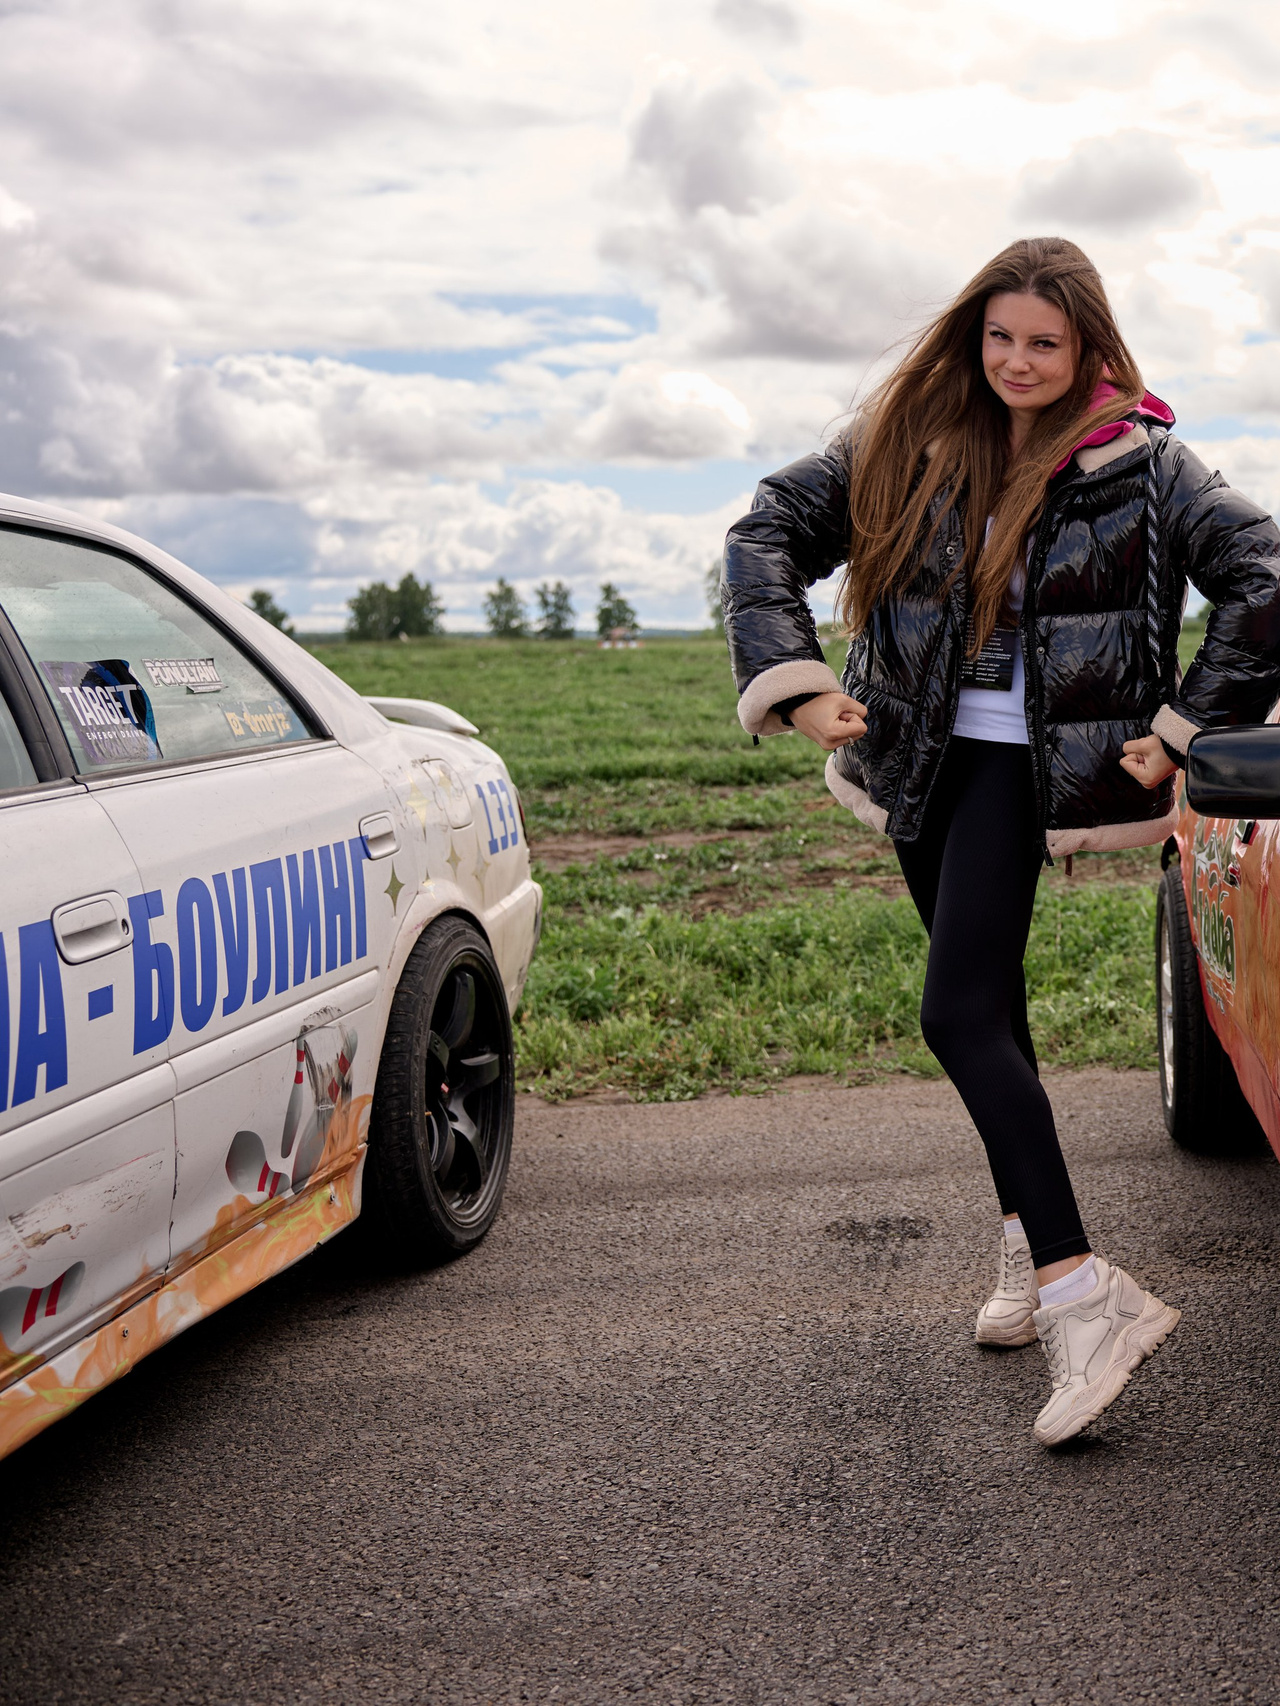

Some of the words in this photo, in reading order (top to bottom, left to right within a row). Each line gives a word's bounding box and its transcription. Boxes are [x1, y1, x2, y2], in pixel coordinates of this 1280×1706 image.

[58, 684, 139, 726] TARGET
[86, 730, 119, 741] ENERGY
[475, 779, 518, 855] 133
[127, 835, 368, 1055] БОУЛИНГ
